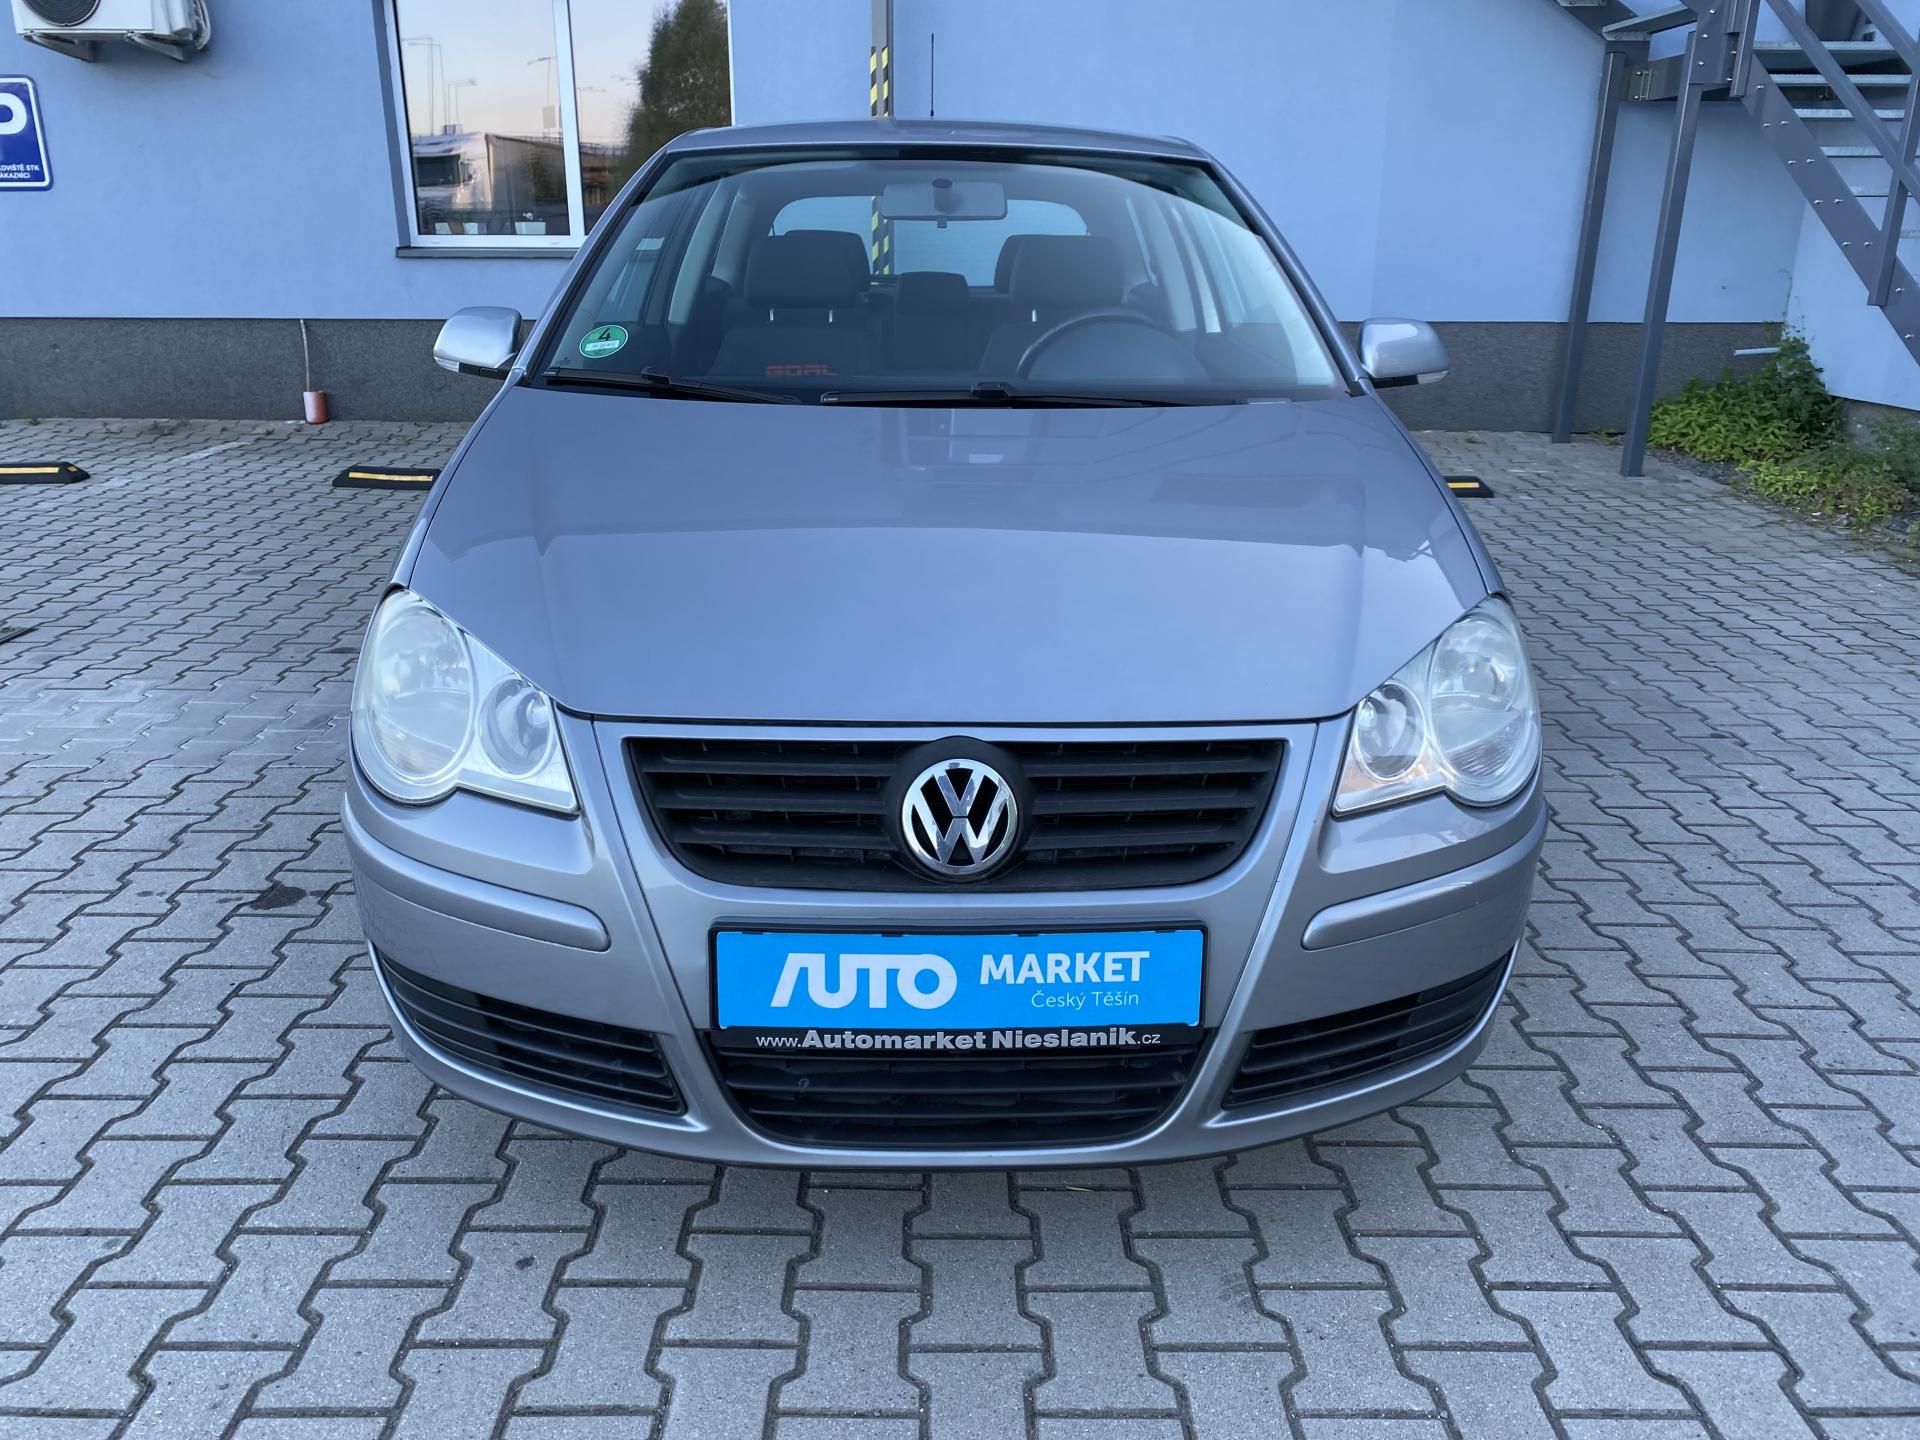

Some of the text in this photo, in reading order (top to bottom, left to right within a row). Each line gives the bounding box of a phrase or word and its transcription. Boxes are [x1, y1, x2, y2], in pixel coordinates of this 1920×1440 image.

[598, 327, 611, 341] 4
[770, 950, 1150, 1010] AUTO MARKET
[1031, 989, 1139, 1011] Český Těšín
